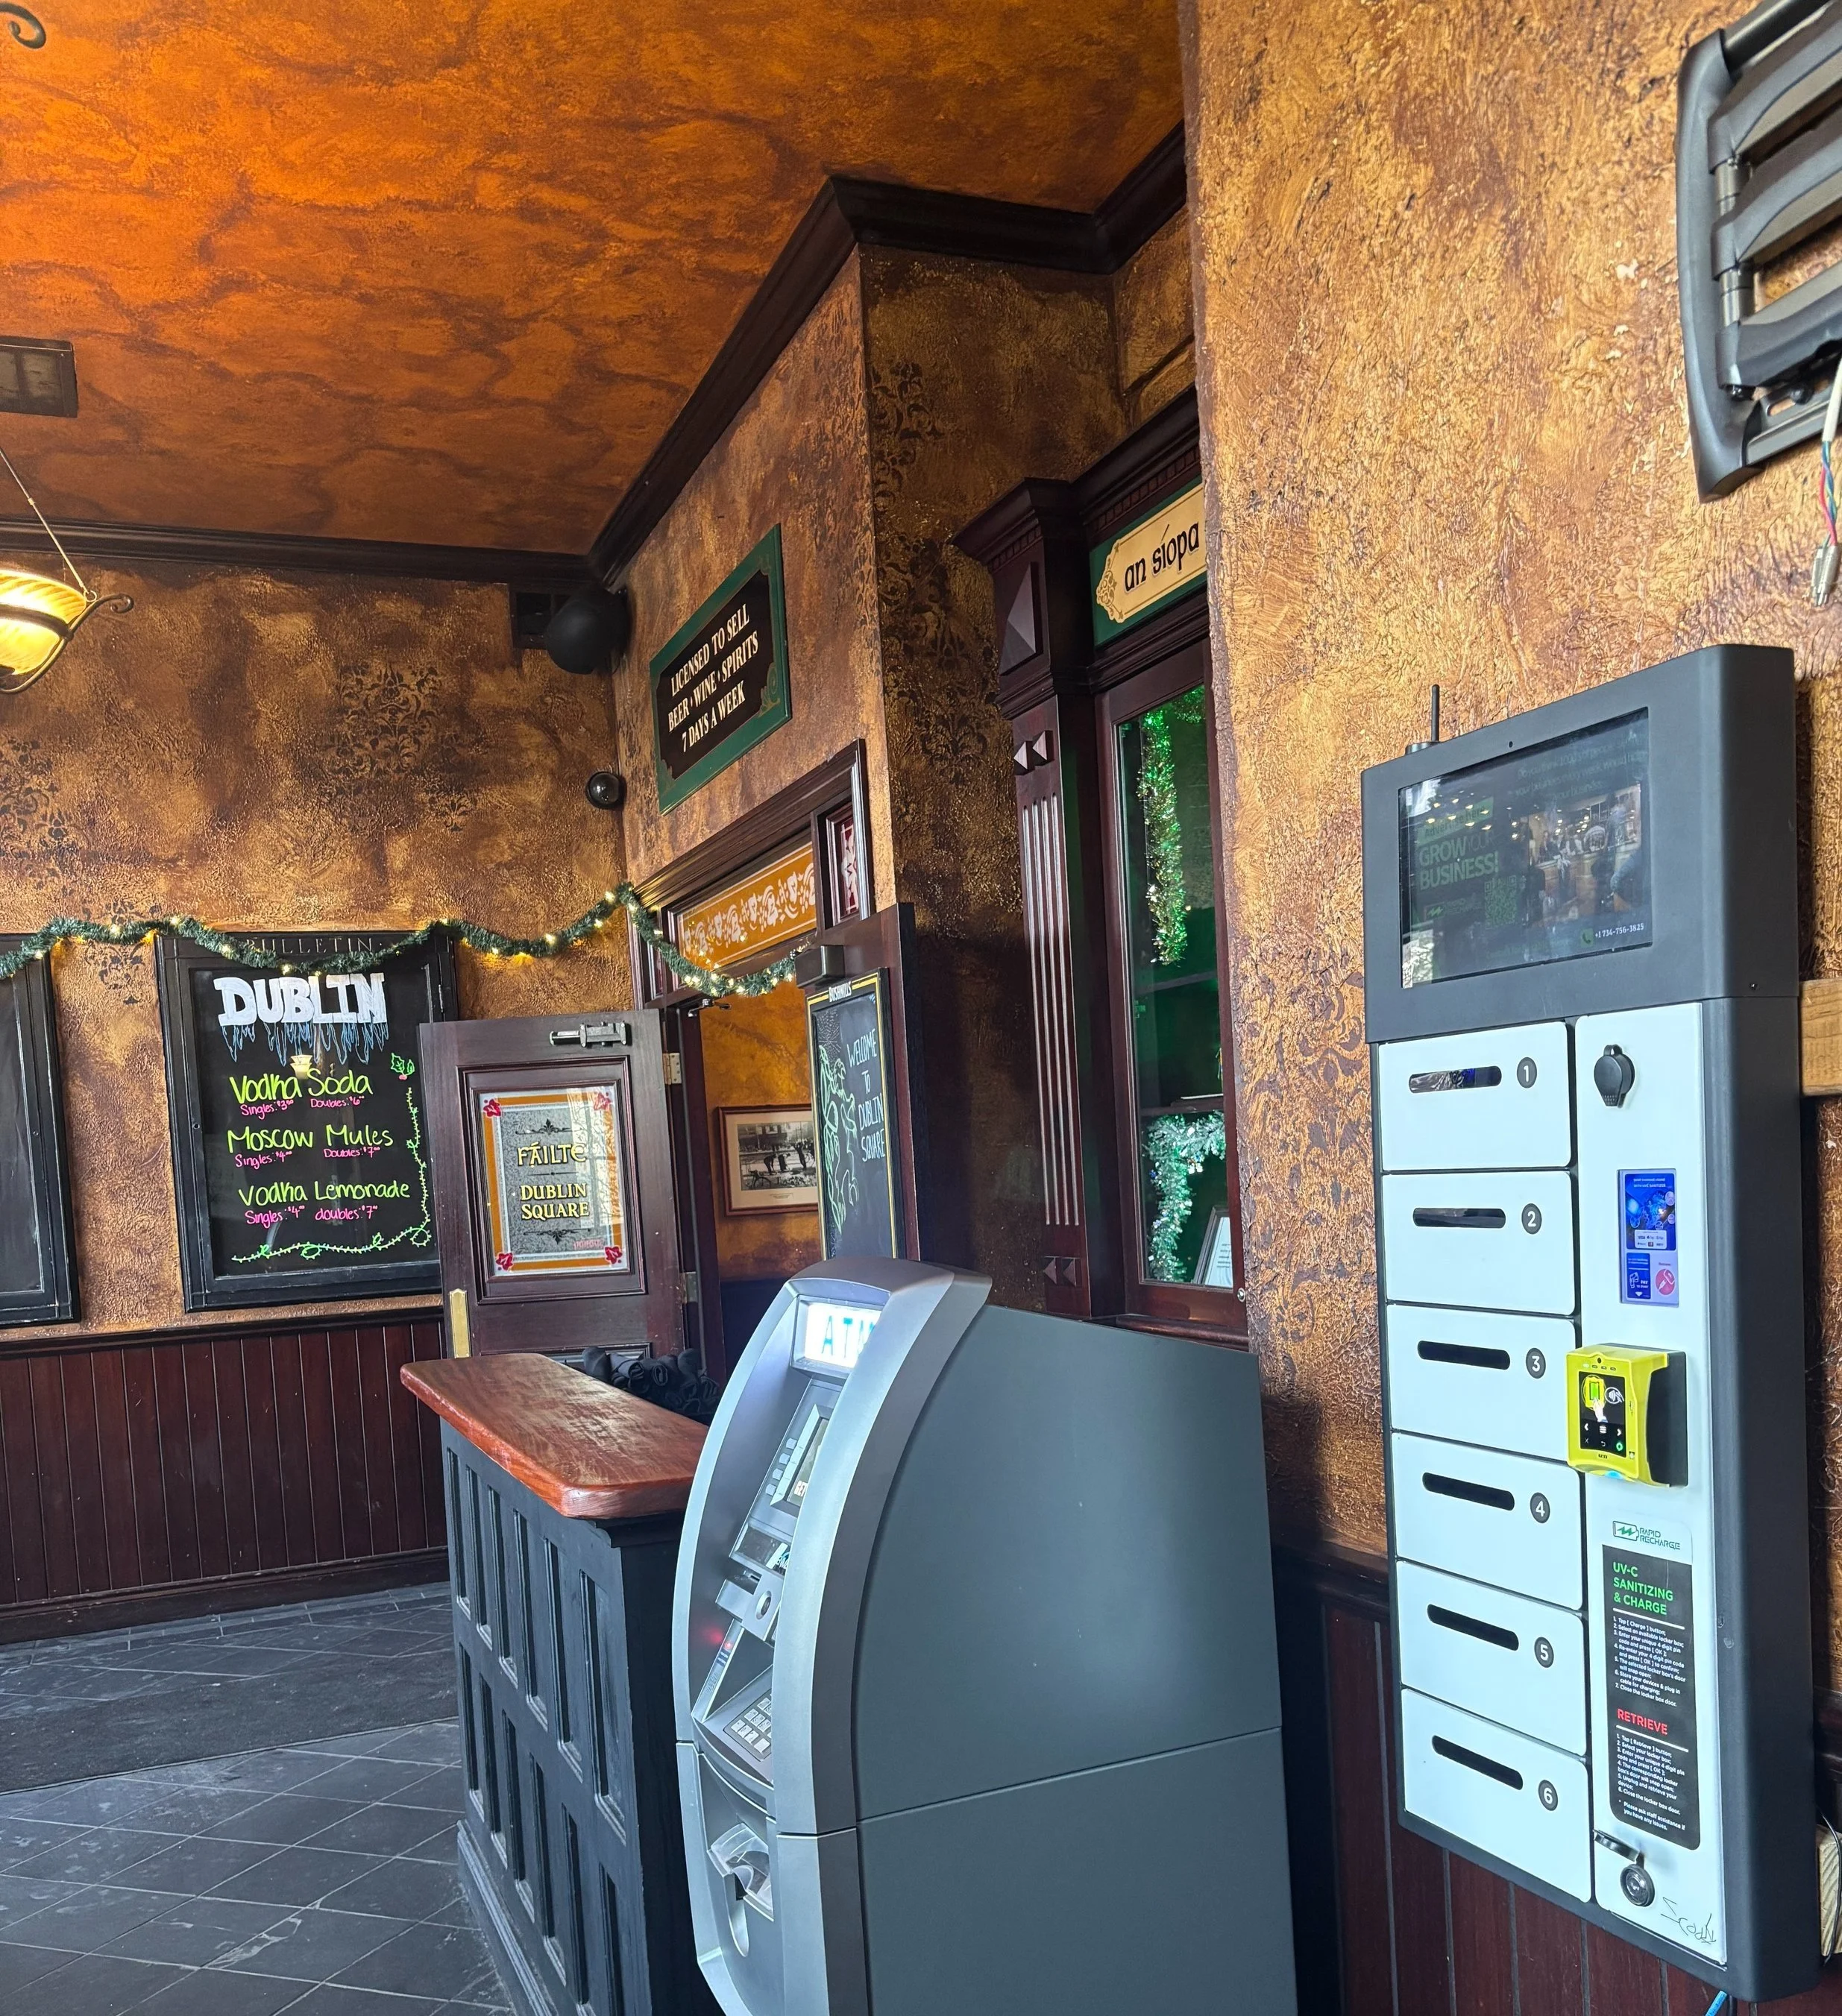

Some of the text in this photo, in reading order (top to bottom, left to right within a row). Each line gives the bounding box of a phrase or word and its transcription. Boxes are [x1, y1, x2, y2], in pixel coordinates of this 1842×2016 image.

[1125, 558, 1146, 592] an
[671, 604, 749, 697] LICENSED TO SELL
[668, 631, 758, 732] BEER WINE SPIRITS
[682, 680, 746, 752] 7 DAYS A WEEK
[1419, 836, 1468, 866] GROW
[1420, 851, 1499, 890] BUSINESS!
[1603, 923, 1644, 937] 734-756-3825
[213, 972, 388, 1027] DUBLIN
[846, 1028, 878, 1068] WELCOME
[307, 1068, 374, 1097] Soda
[1523, 1065, 1530, 1083] 1
[858, 1093, 884, 1131] DUBLIN
[227, 1124, 394, 1153] Moscow Mules
[861, 1129, 886, 1162] SQUARE
[314, 1179, 410, 1200] Lemonade
[520, 1182, 587, 1201] DUBLIN
[521, 1202, 590, 1220] SQUARE
[1527, 1210, 1537, 1227] 2
[1531, 1355, 1541, 1373] 3
[1535, 1500, 1546, 1517] 4
[1640, 1527, 1661, 1538] RAPID
[1640, 1536, 1680, 1550] RECHARGE
[1613, 1562, 1638, 1578] UV-C
[1613, 1577, 1673, 1601] SANITIZING
[1614, 1593, 1667, 1615] & CHARGE
[1540, 1643, 1549, 1661] 5
[1617, 1708, 1667, 1735] RETRIEVE
[1543, 1787, 1553, 1804] 6
